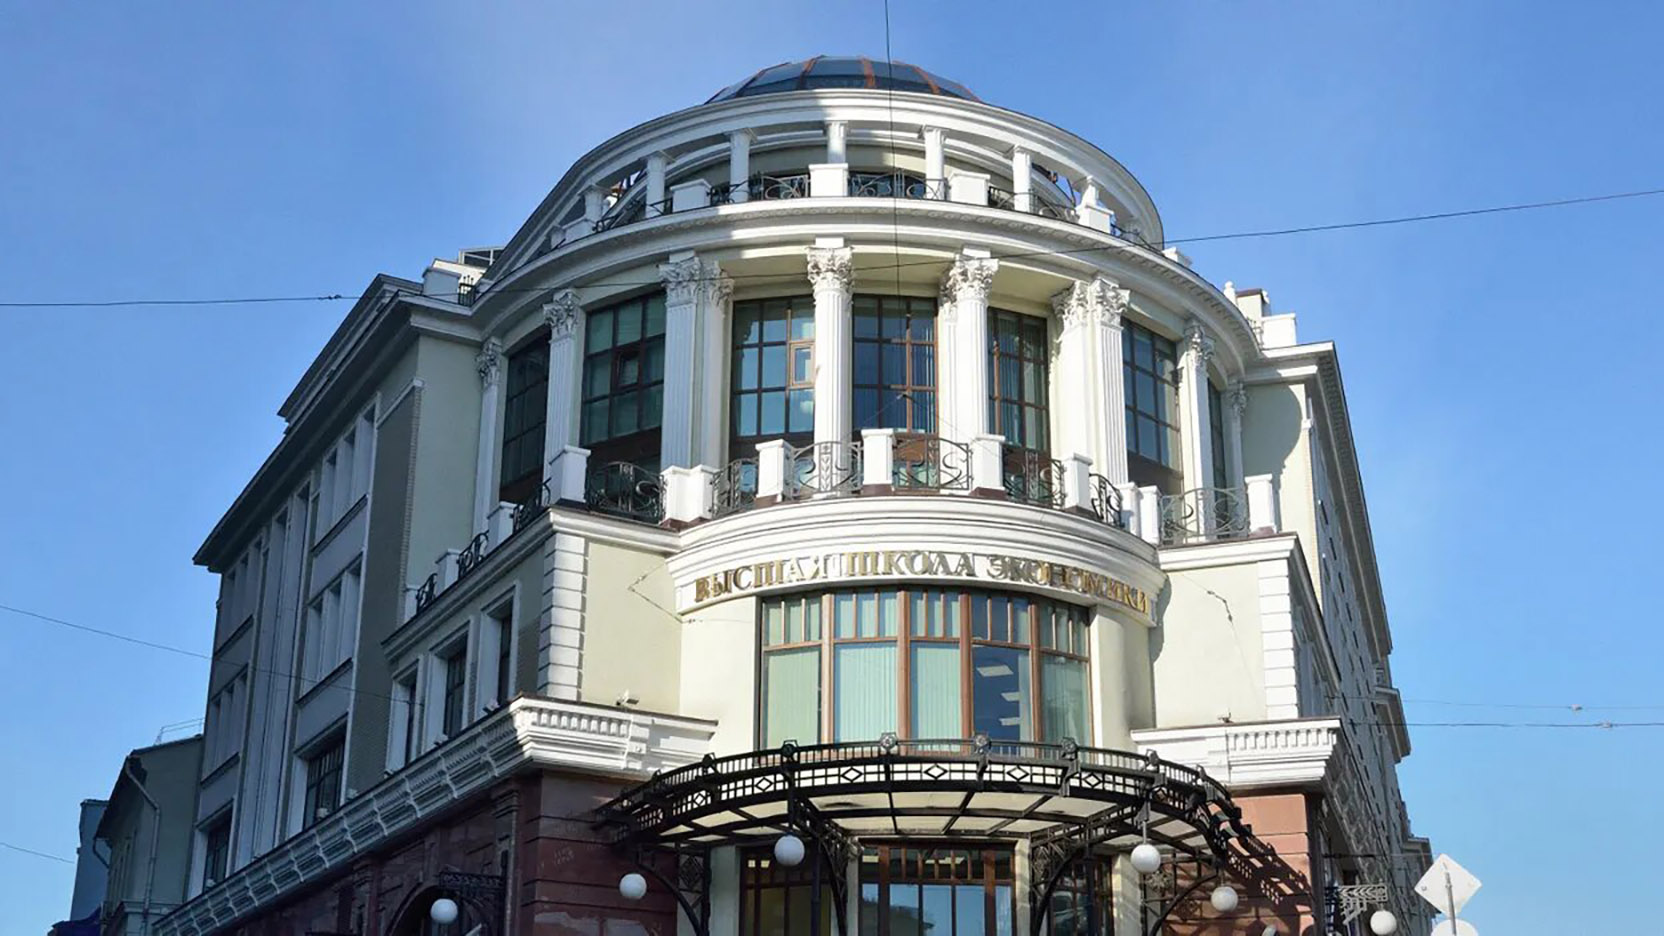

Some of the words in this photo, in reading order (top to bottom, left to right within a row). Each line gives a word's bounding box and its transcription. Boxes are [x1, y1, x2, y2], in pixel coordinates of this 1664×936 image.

[695, 555, 830, 602] ВЫСШАЯ
[842, 550, 977, 577] ШКОЛА
[986, 554, 1150, 614] ЭКОНОМИКИ
